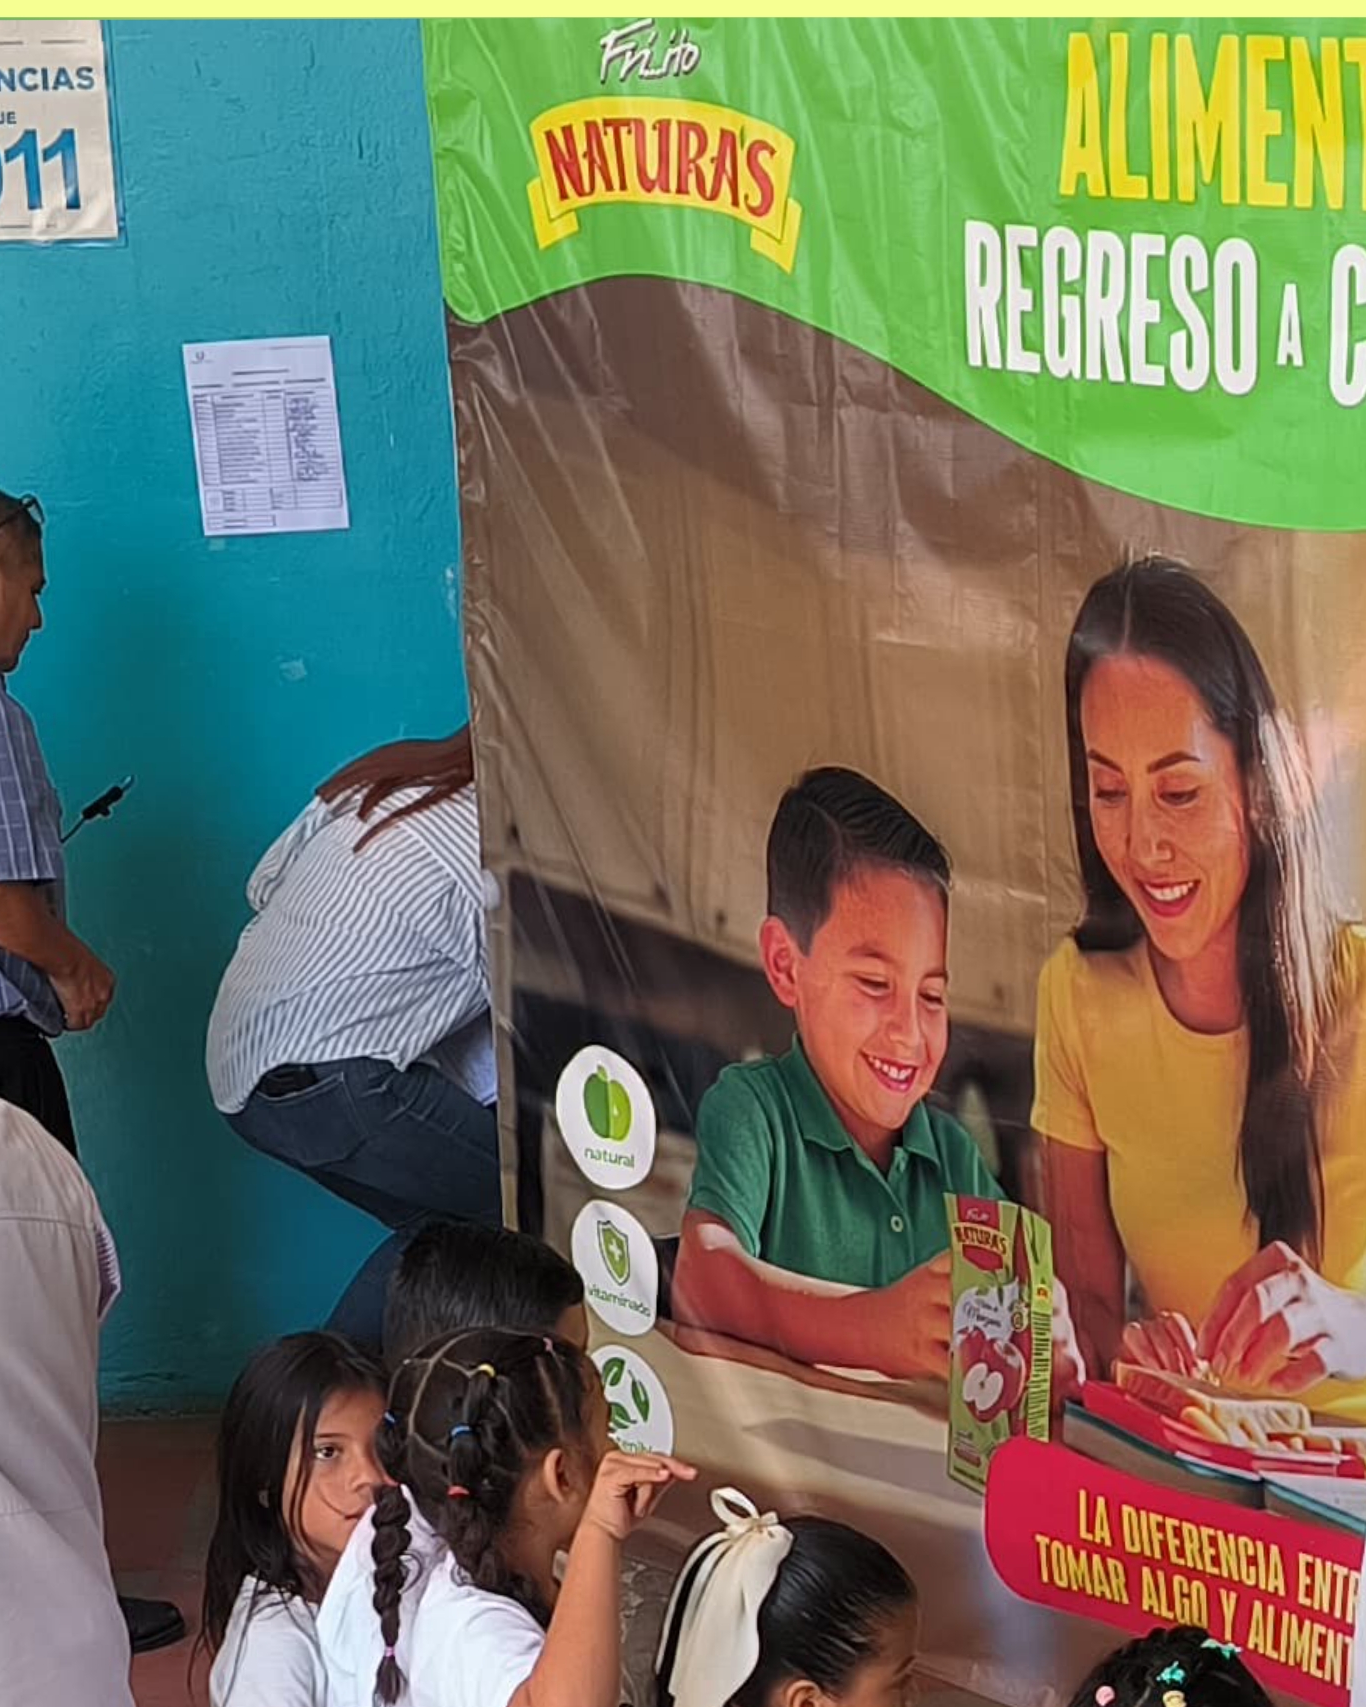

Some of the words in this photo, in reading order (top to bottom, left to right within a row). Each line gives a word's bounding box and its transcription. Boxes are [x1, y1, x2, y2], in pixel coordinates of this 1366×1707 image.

[544, 117, 777, 217] NATURA'S
[965, 220, 1259, 396] REGRESO
[1276, 283, 1304, 367] A
[584, 1146, 635, 1168] natural
[1035, 1534, 1129, 1605] TOMAR
[1141, 1565, 1209, 1628] ALGO
[1219, 1587, 1238, 1642] Y
[1247, 1600, 1355, 1691] ALIMENT
[1078, 1488, 1113, 1548] LA
[1121, 1503, 1286, 1597] DIFERENCIA
[1298, 1551, 1360, 1625] ENTR
